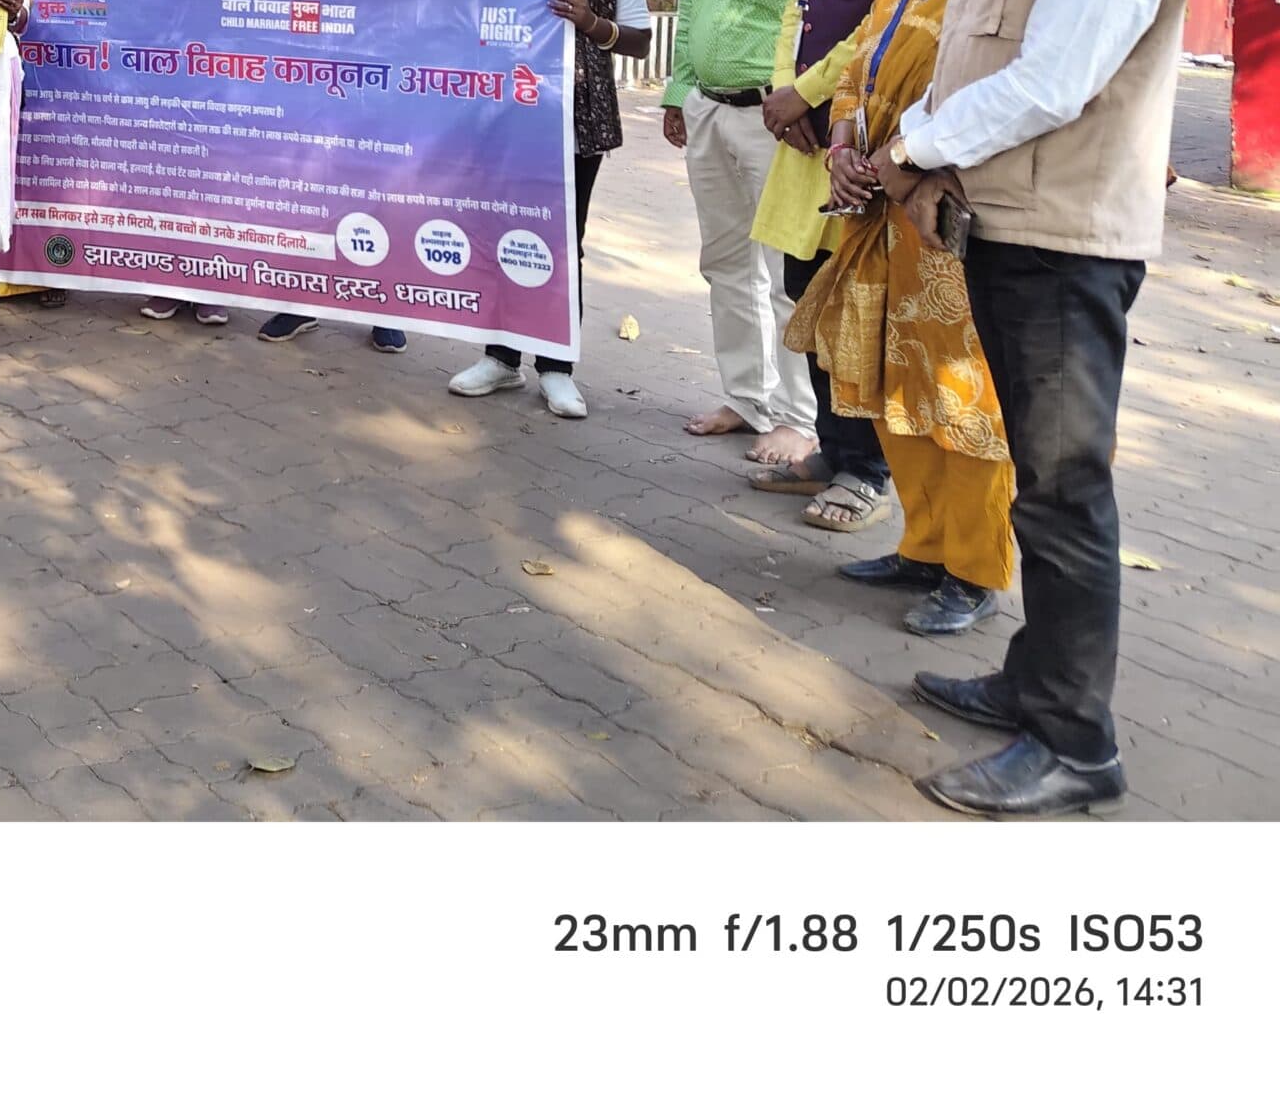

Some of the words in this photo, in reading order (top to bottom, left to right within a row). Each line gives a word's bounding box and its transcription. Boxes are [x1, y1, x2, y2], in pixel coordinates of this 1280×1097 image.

[293, 1, 319, 17] मुक्त
[322, 4, 356, 19] भारत
[481, 7, 517, 24] JUST
[221, 17, 245, 28] CHILD
[246, 18, 290, 31] MARRIAGE
[292, 21, 318, 33] FREE
[321, 22, 355, 34] INDIA
[480, 23, 532, 43] RIGHTS
[20, 39, 109, 71] वधान!
[120, 45, 181, 75] बाल
[185, 42, 268, 83] विवाह
[273, 55, 392, 100] कानूनन
[399, 63, 506, 102] अपराध
[512, 62, 543, 106] है
[54, 89, 61, 98] के
[62, 89, 79, 102] लड़के
[81, 91, 91, 101] और
[102, 92, 111, 103] वर्ष
[114, 93, 119, 103] से
[120, 96, 132, 104] कम
[134, 96, 148, 108] आयु
[150, 95, 158, 105] की
[191, 100, 205, 109] बाल
[207, 100, 225, 112] विवाह
[227, 104, 250, 117] कानूनन
[252, 106, 274, 115] अपराध
[30, 208, 46, 220] सब
[48, 206, 82, 223] मिलकर
[83, 210, 98, 226] इसे
[100, 213, 114, 229] जड़
[116, 213, 125, 227] से
[126, 213, 157, 231] मिटाये,
[159, 220, 173, 232] सब
[176, 218, 197, 235] बच्चों
[199, 222, 212, 237] को
[213, 224, 235, 240] उनके
[237, 226, 275, 246] अधिकार
[351, 238, 375, 253] 112
[424, 248, 462, 265] 1098
[500, 256, 518, 266] 1800
[519, 260, 532, 268] 102
[83, 243, 174, 273] झारखण्ड
[178, 251, 249, 284] ग्रामीण
[252, 258, 329, 293] विकास
[333, 274, 388, 305] ट्रस्ट,
[394, 282, 482, 314] धनबाद
